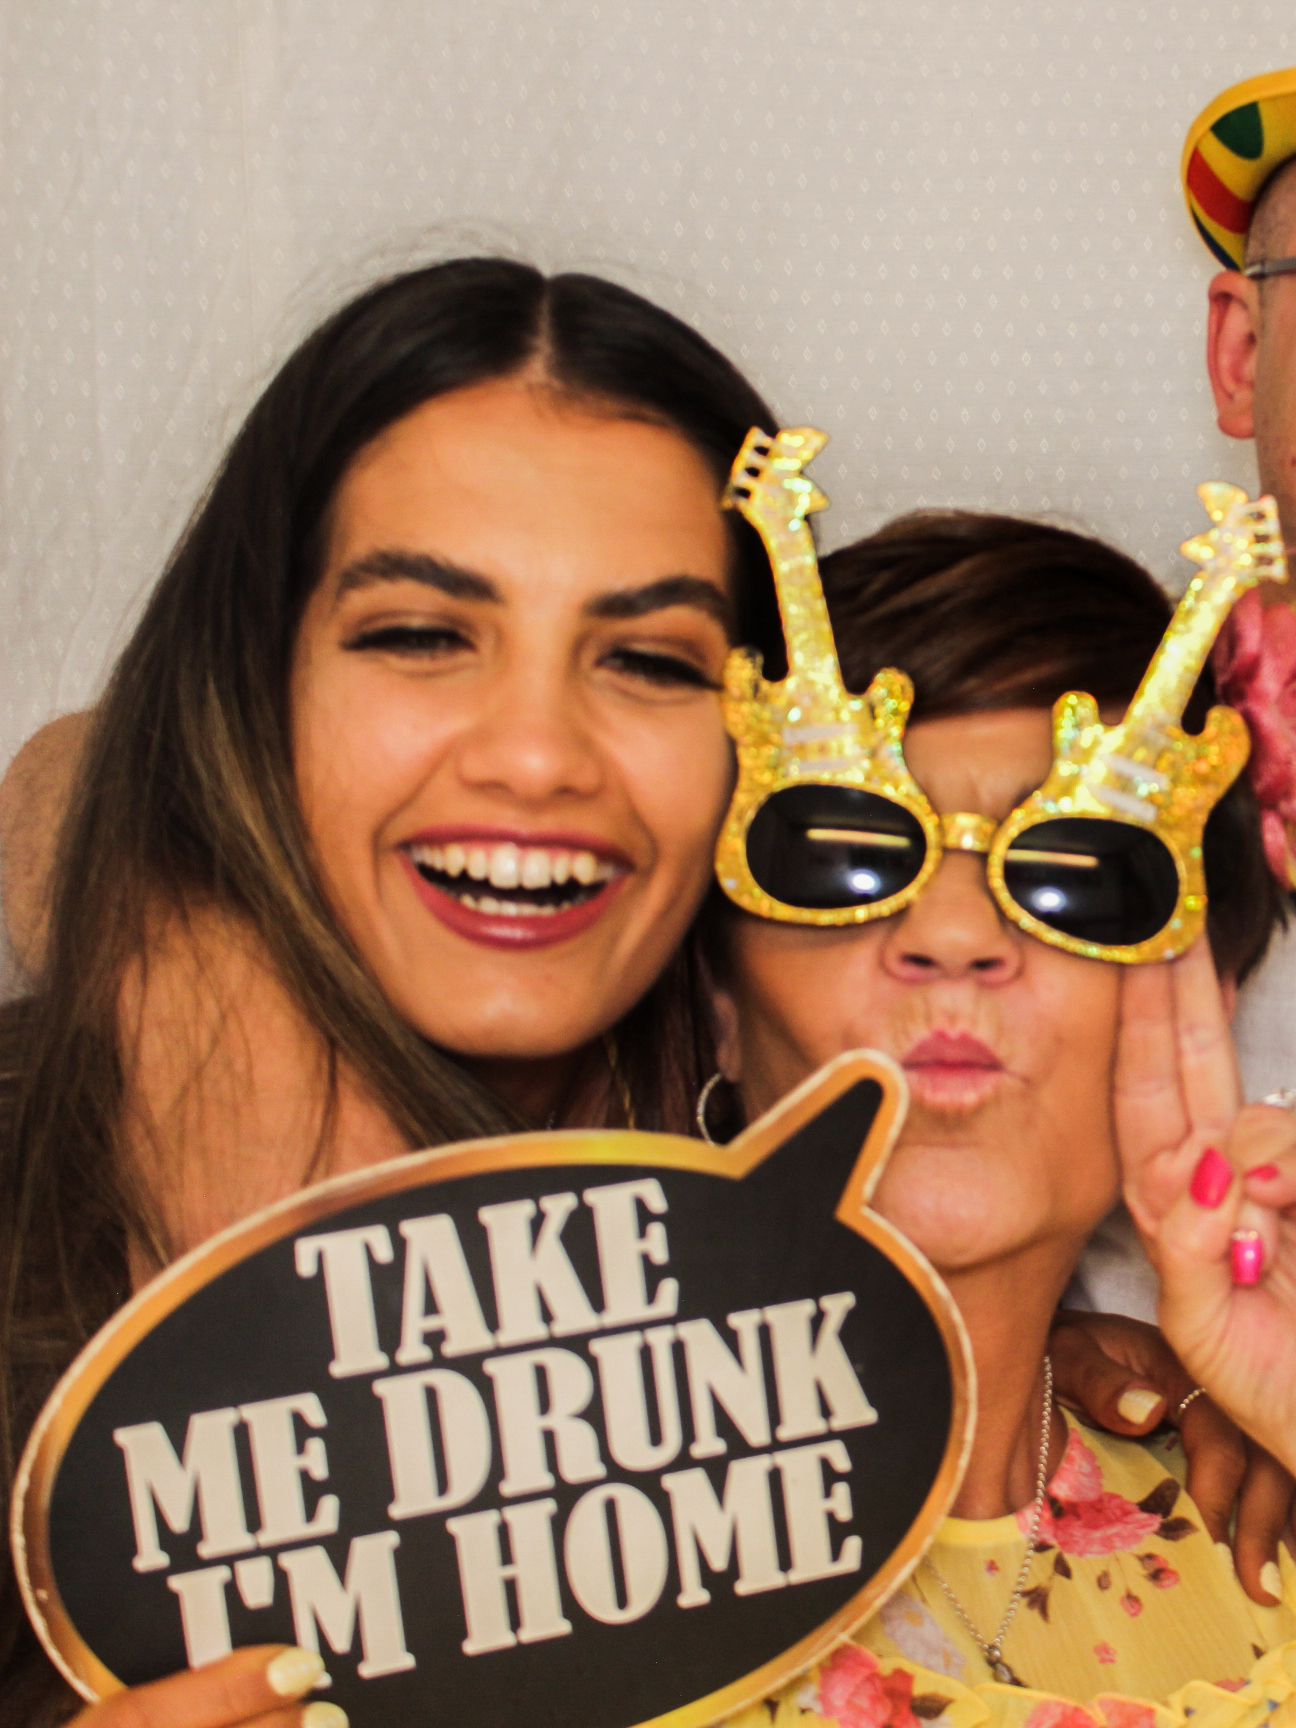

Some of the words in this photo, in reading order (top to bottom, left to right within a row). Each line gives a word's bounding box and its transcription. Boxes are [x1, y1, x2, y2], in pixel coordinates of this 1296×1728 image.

[294, 1178, 680, 1379] TAKE
[113, 1391, 340, 1573] ME
[372, 1291, 879, 1520] DRUNK
[167, 1530, 416, 1688] I'M
[445, 1440, 863, 1656] HOME
